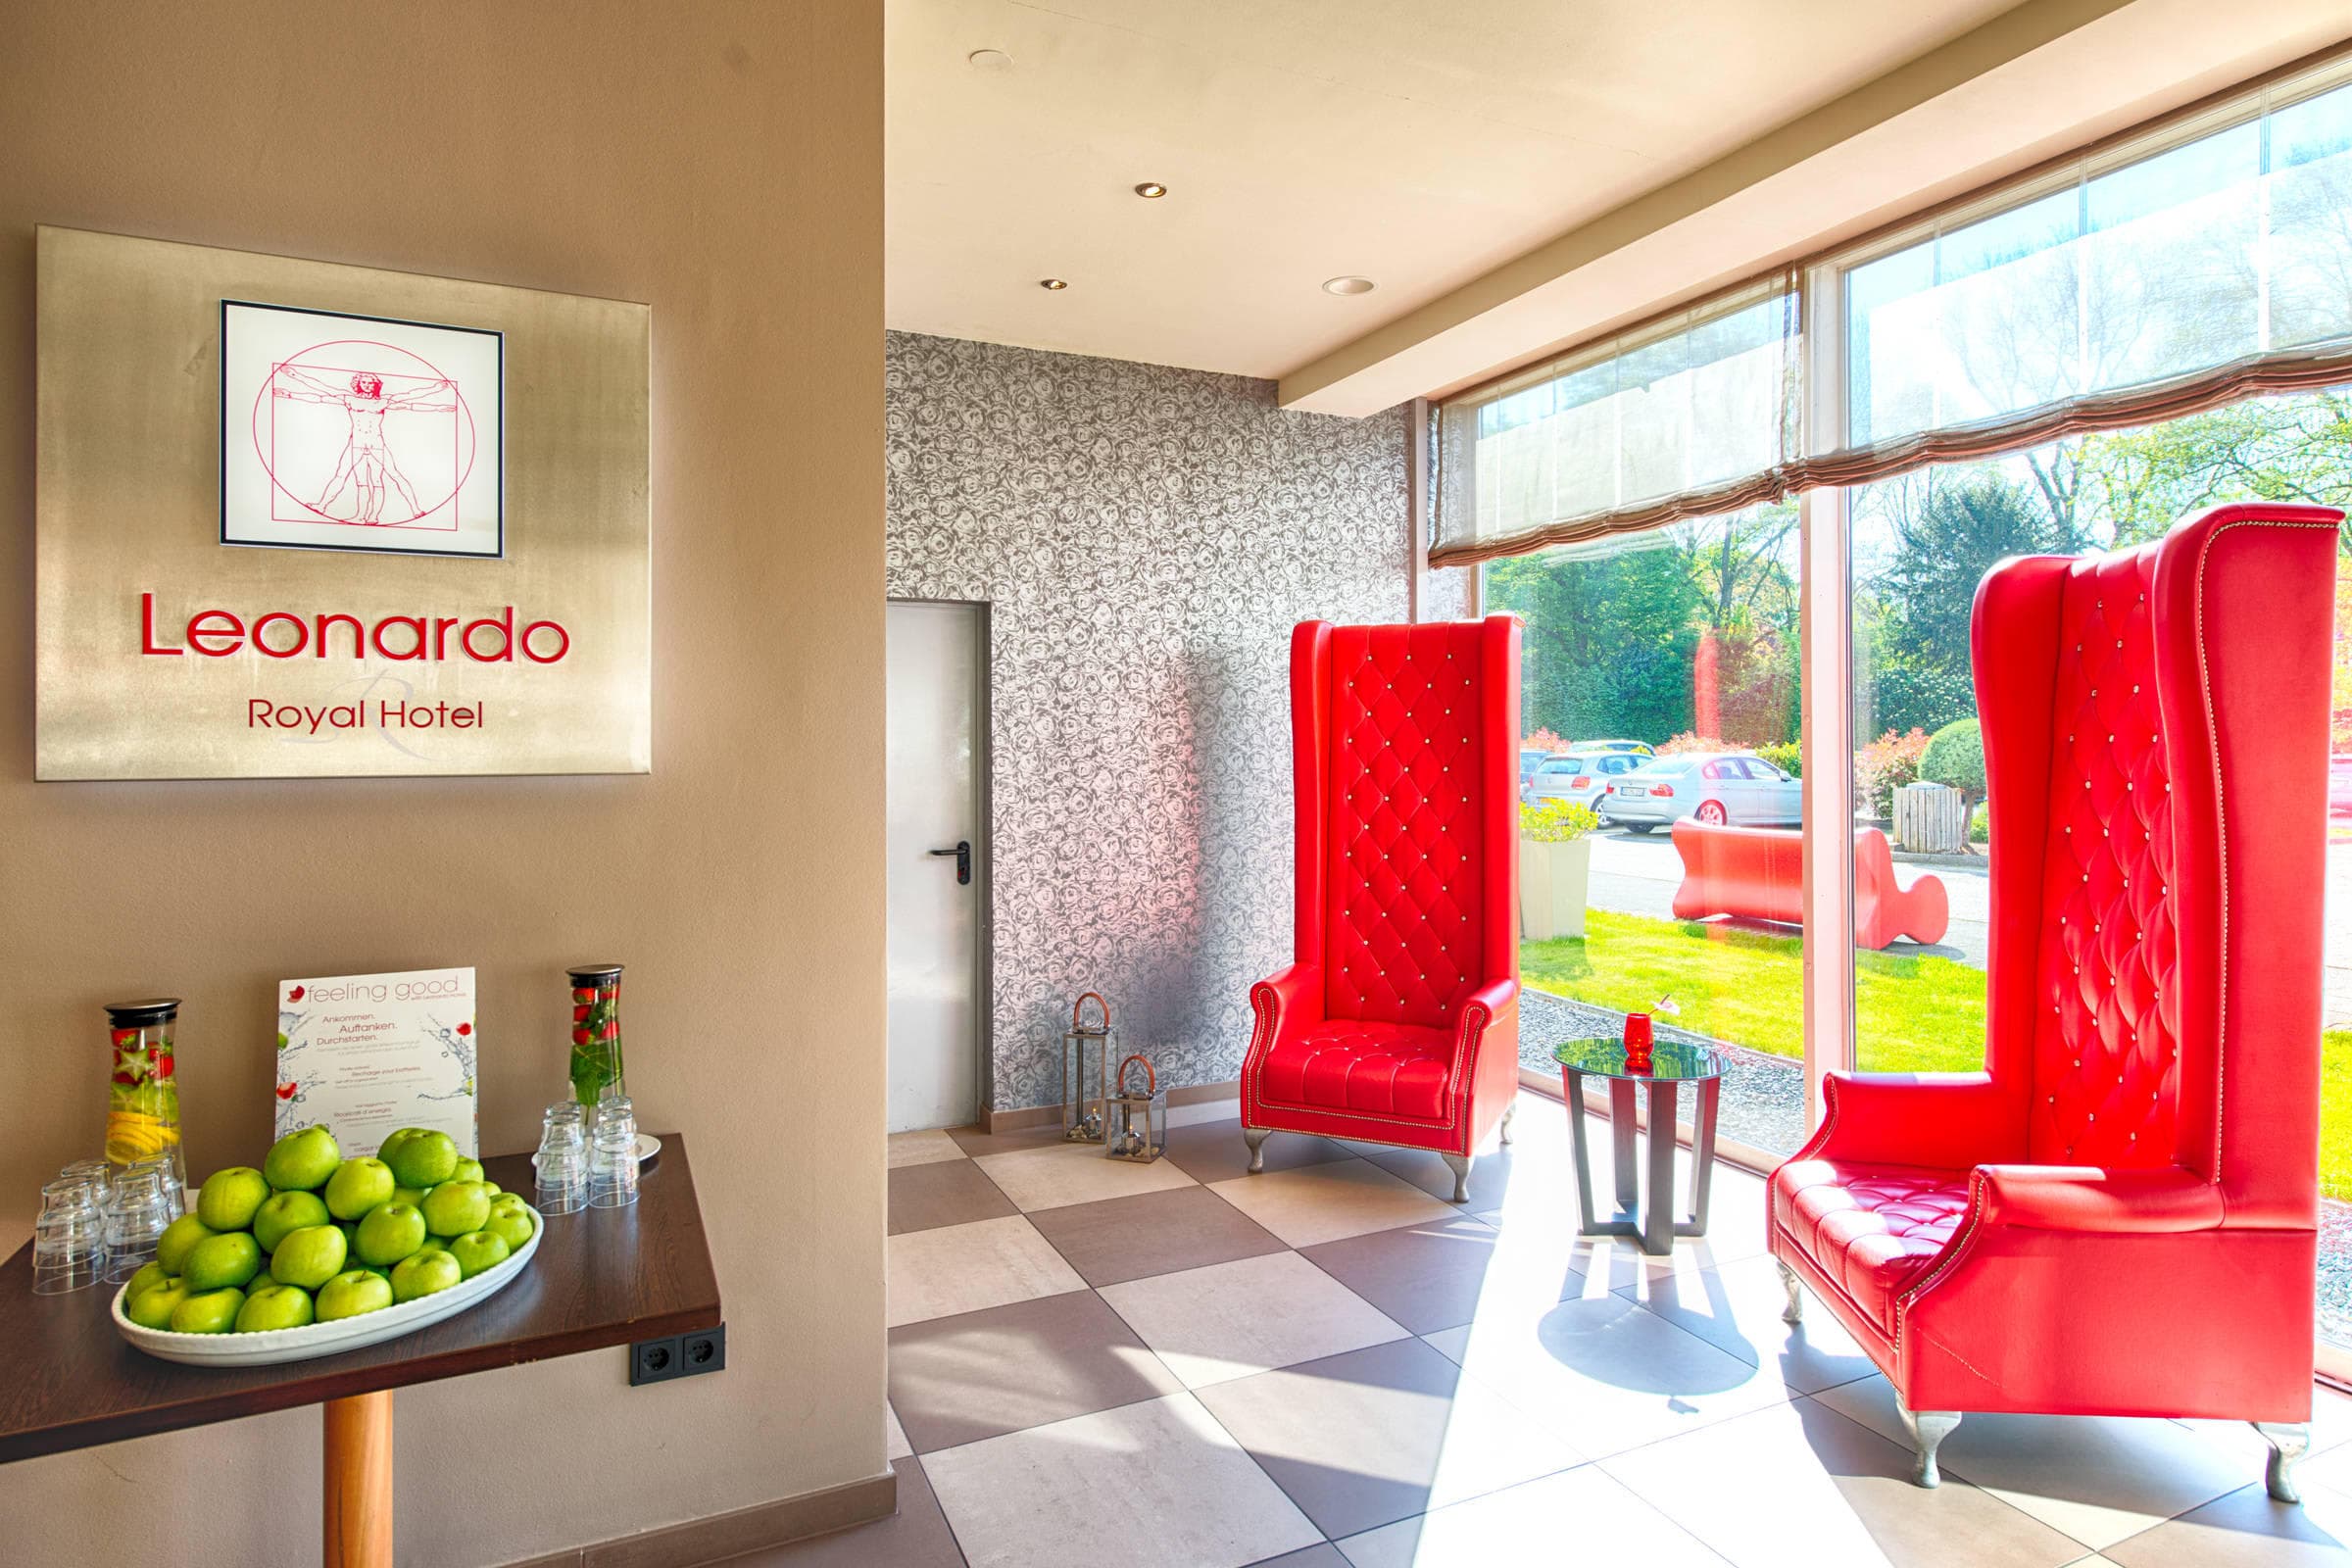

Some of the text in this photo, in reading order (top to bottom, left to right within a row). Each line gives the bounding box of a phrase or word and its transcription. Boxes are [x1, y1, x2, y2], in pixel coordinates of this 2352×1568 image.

[142, 593, 570, 663] Leonardo
[249, 699, 483, 735] Royal Hotel
[308, 975, 459, 1004] feeling good
[321, 1012, 376, 1024] Ankommen.
[339, 1021, 398, 1034] Auftanken.
[317, 1033, 378, 1046] Durchstarten.
